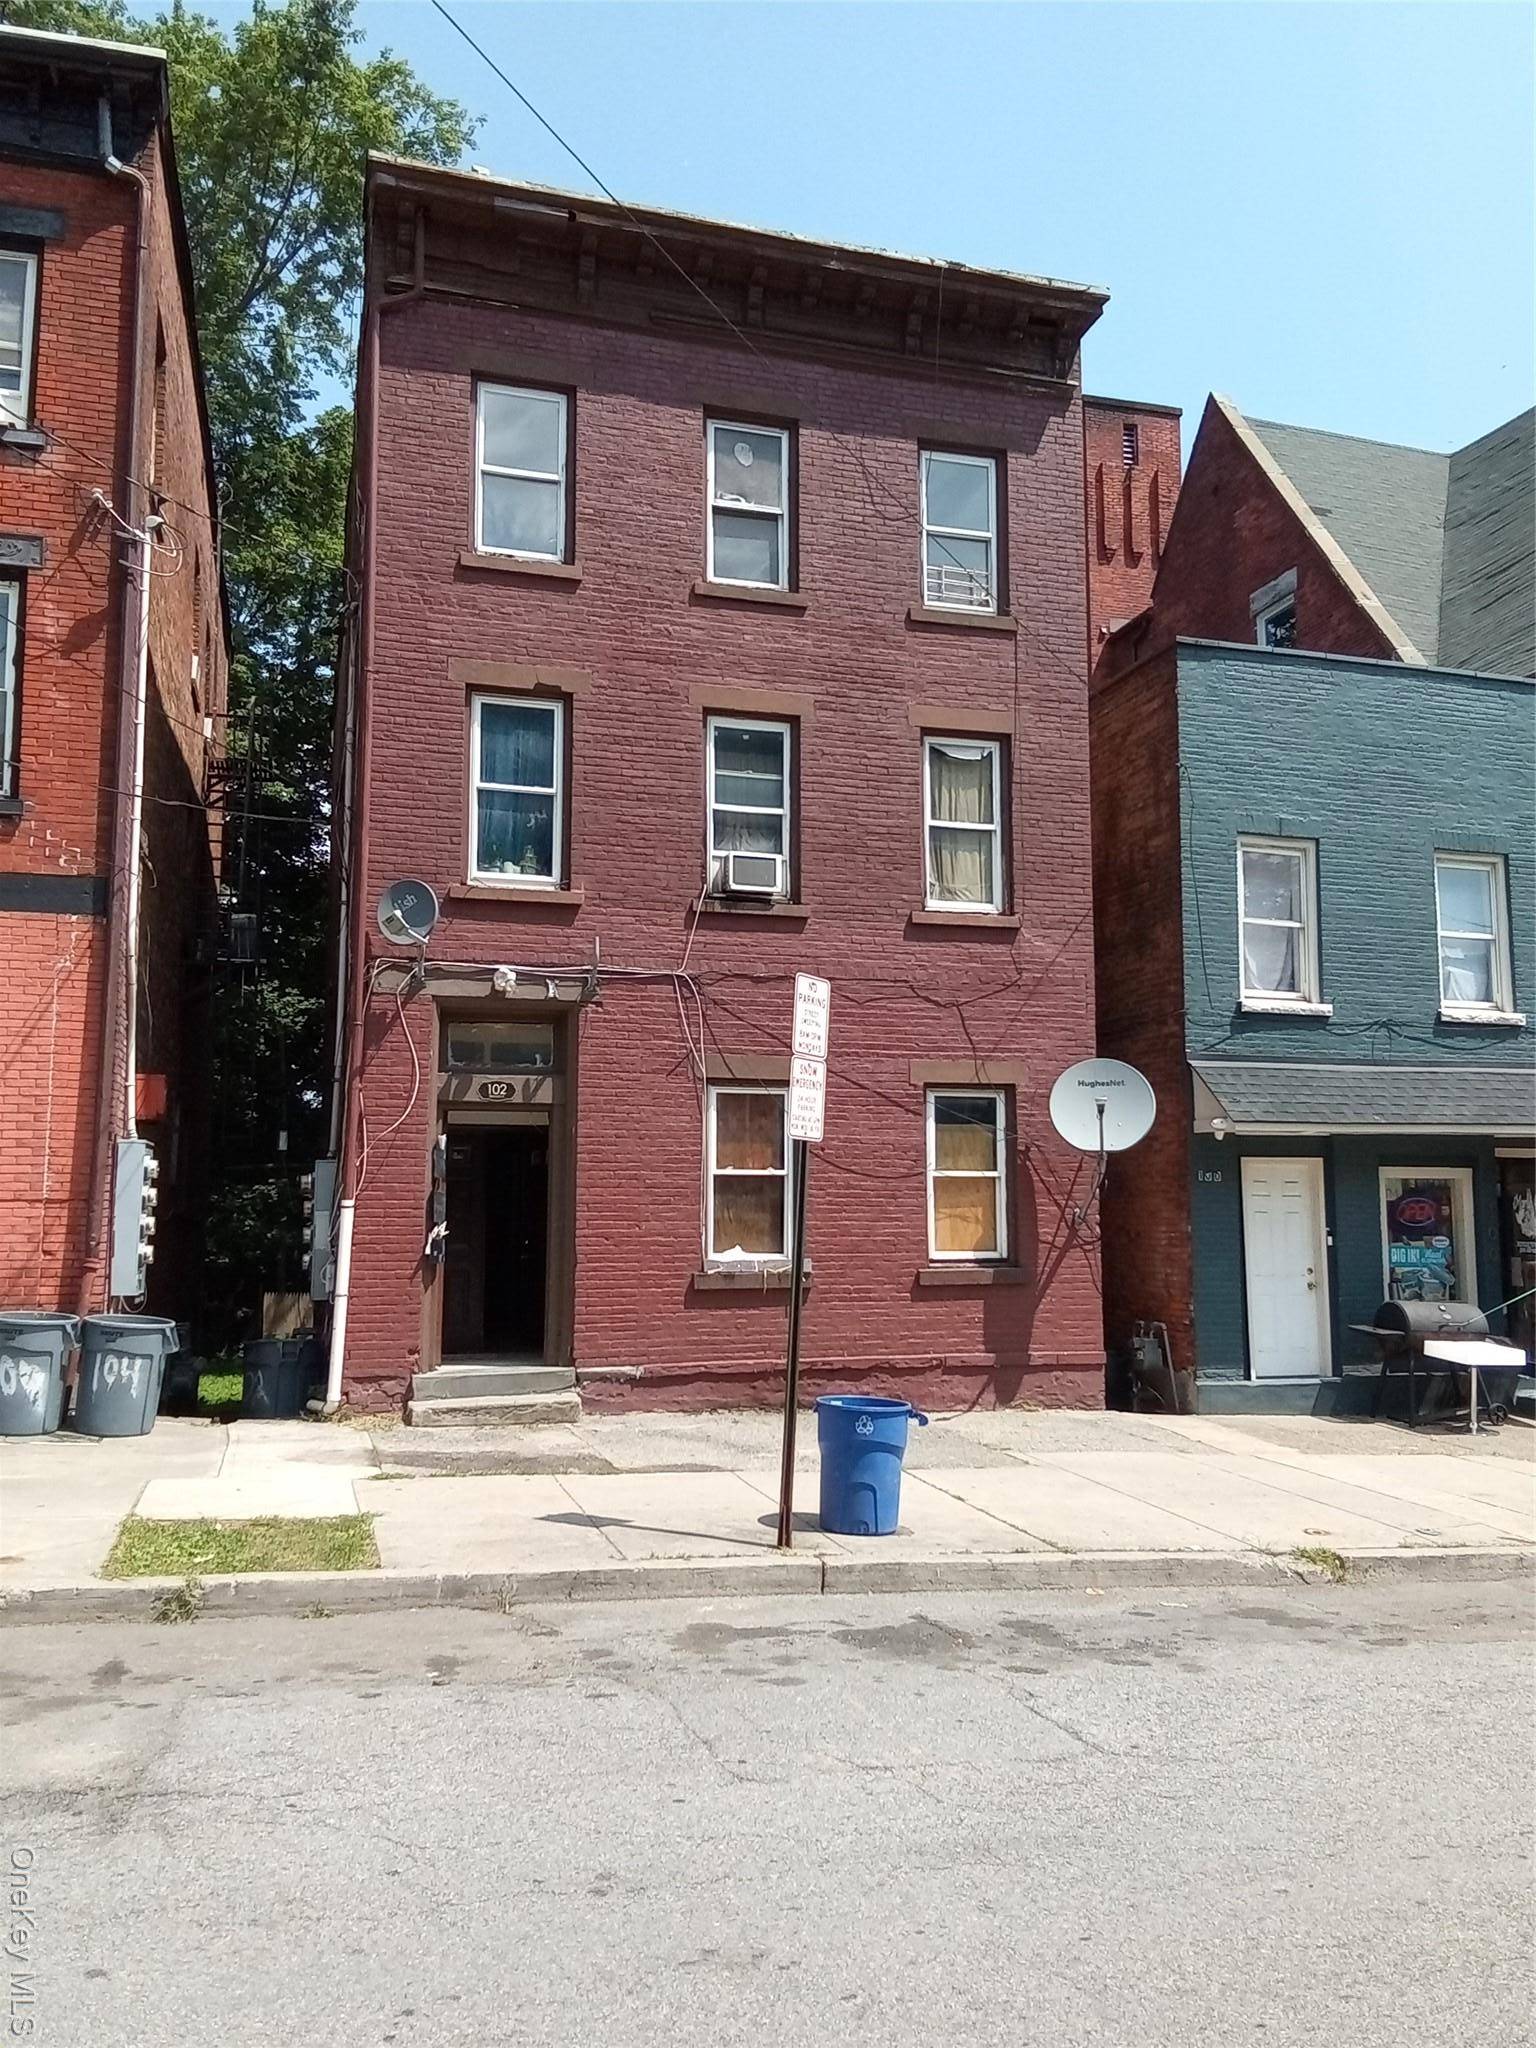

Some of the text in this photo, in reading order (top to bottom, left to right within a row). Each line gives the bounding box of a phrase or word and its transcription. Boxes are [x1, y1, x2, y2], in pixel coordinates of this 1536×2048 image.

[808, 981, 818, 993] NO
[798, 993, 826, 1009] PARKING
[799, 1063, 818, 1076] SNOW
[487, 1083, 508, 1096] 102
[792, 1077, 823, 1091] EMERGENCY
[1077, 1079, 1126, 1088] HughesNet
[92, 1352, 143, 1399] 104
